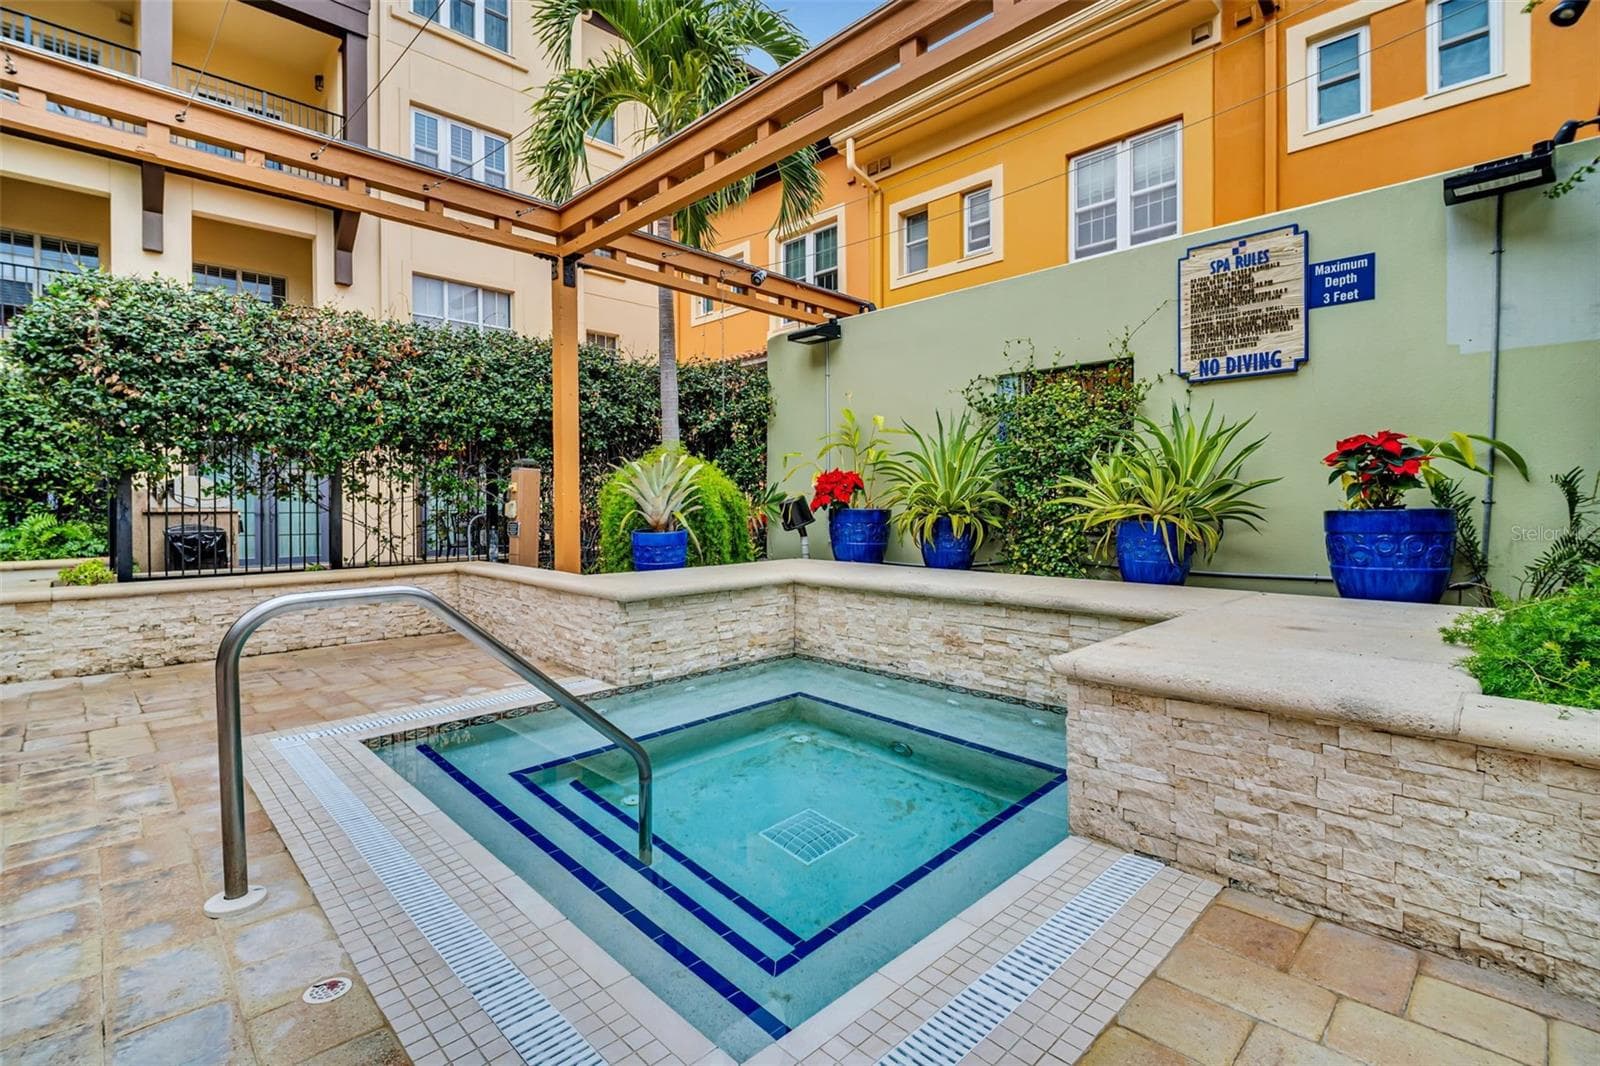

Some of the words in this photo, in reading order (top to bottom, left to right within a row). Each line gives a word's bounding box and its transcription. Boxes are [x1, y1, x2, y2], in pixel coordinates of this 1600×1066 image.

[1210, 258, 1231, 274] SPA
[1235, 249, 1270, 269] RULES
[1315, 258, 1368, 276] Maximum
[1325, 273, 1358, 288] Depth
[1323, 293, 1330, 304] 3
[1333, 289, 1359, 302] Feet
[1200, 359, 1220, 377] NO
[1226, 350, 1282, 374] DIVING
